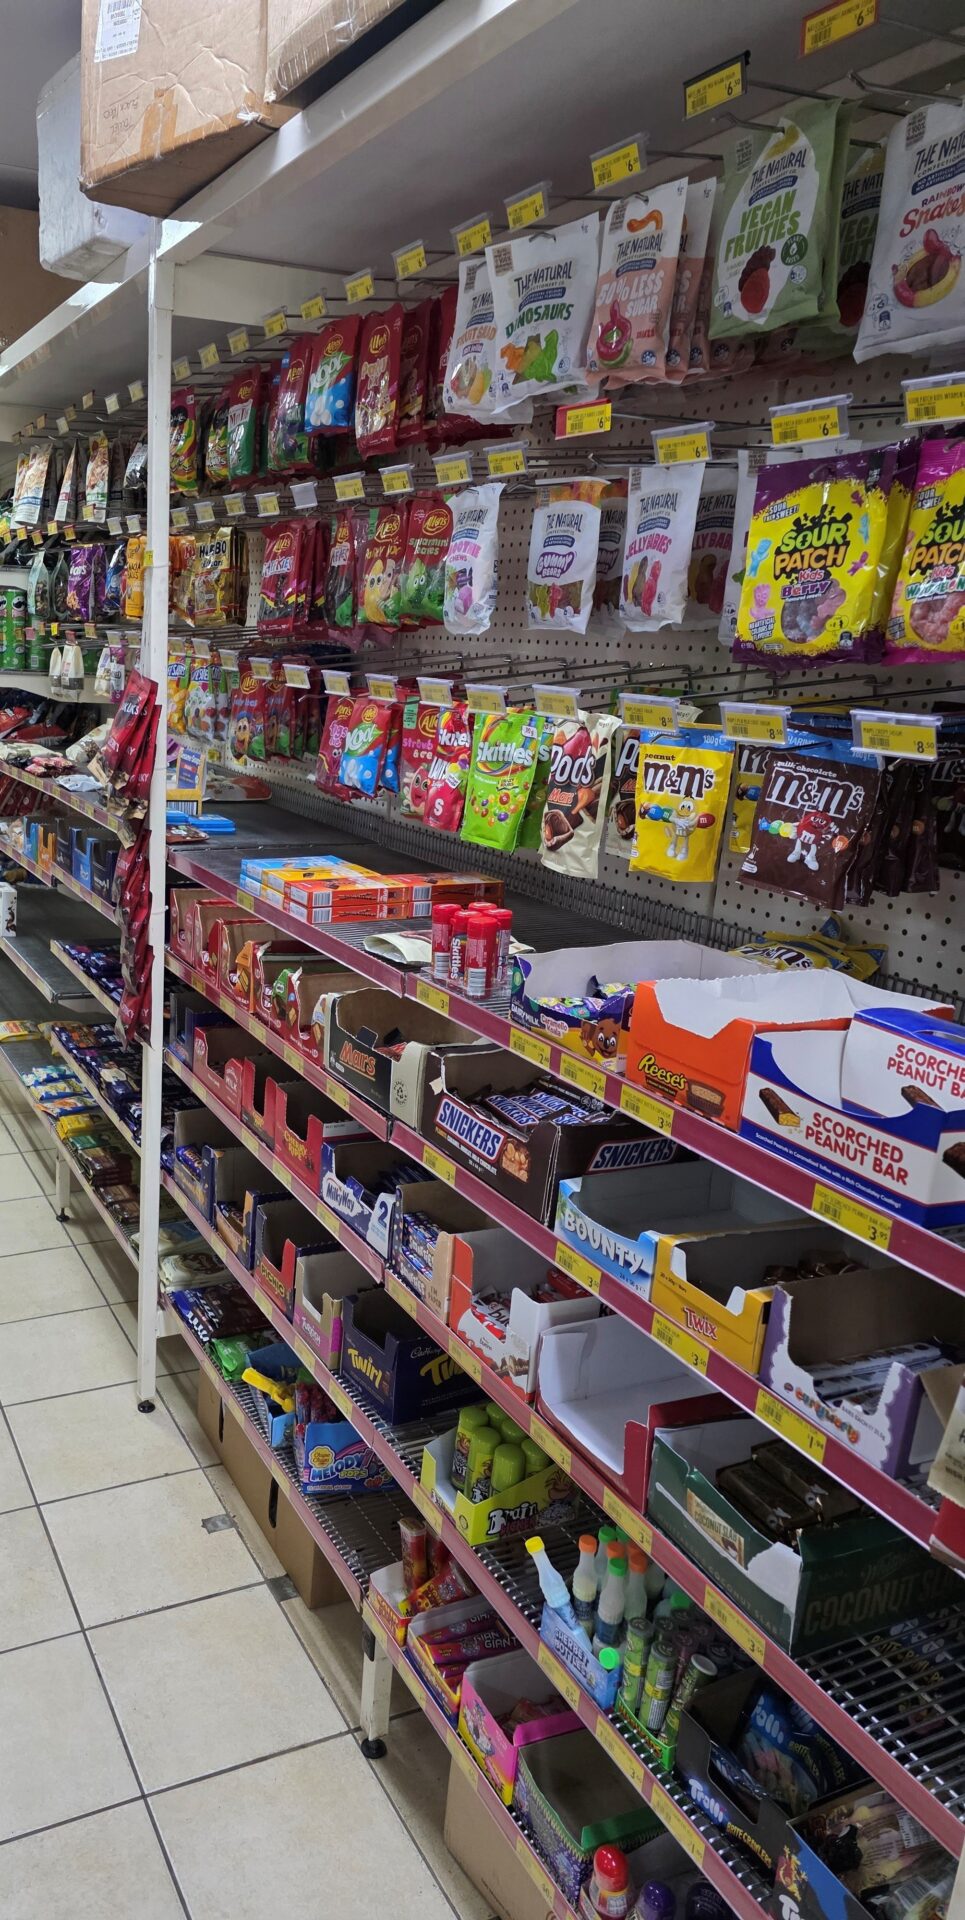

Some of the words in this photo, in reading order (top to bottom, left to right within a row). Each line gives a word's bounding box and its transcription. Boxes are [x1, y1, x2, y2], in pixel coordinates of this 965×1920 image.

[751, 170, 765, 189] THE
[765, 148, 807, 174] NATURAL
[914, 143, 938, 175] THE
[742, 190, 797, 232] VEGAN
[617, 243, 632, 263] THE
[631, 233, 664, 254] NATURAL
[724, 211, 801, 264] FRUITIES
[514, 276, 532, 298] THE
[530, 261, 573, 289] NATURAL
[630, 270, 665, 299] LESS
[505, 302, 575, 338] DINOSAURS
[625, 295, 659, 318] SUGAR
[819, 422, 838, 436] $6.50
[692, 445, 707, 458] $6.50
[649, 493, 679, 513] NATURAL
[555, 513, 583, 532] NATURAL
[780, 522, 849, 552] SOUR
[692, 534, 709, 551] LLY
[536, 553, 573, 573] GUMMY
[773, 545, 847, 577] PATCH
[798, 568, 825, 582] Kids
[781, 580, 831, 600] Berry
[658, 717, 674, 730] $8.50
[766, 727, 784, 742] $8.50
[477, 741, 533, 767] Skittles
[644, 753, 676, 762] peanut
[913, 740, 935, 755] $8.50
[551, 743, 596, 786] Pods
[796, 765, 837, 780] chocolate
[548, 788, 575, 804] Mars
[643, 762, 715, 800] m&m's
[765, 767, 864, 819] m&m's
[450, 937, 462, 980] Skittles
[540, 1014, 568, 1033] Caramello
[546, 1024, 562, 1036] Koala
[339, 1040, 376, 1077] Mars
[638, 1053, 688, 1090] Reese's
[887, 1057, 945, 1091] PEANUT
[488, 1095, 536, 1126] SNICKERS
[438, 1101, 502, 1158] SNICKERS
[811, 1112, 904, 1165] SCORCHED
[594, 1138, 678, 1168] SNICKERS
[805, 1126, 868, 1167] PEANUT
[872, 1159, 909, 1186] BAR
[377, 1200, 389, 1228] 2
[564, 1208, 645, 1275] BOUNTY
[867, 1225, 888, 1242] $3.95
[260, 1263, 286, 1297] PICNIC
[348, 1348, 384, 1390] Twirl
[310, 1452, 365, 1483] MELODY
[339, 1469, 368, 1480] POPS
[487, 1502, 537, 1536] Brain
[803, 1574, 917, 1637] COCONUT
[688, 1778, 724, 1824] Trolli
[726, 1822, 745, 1840] BRITE
[742, 1833, 773, 1870] CRAWLERS
